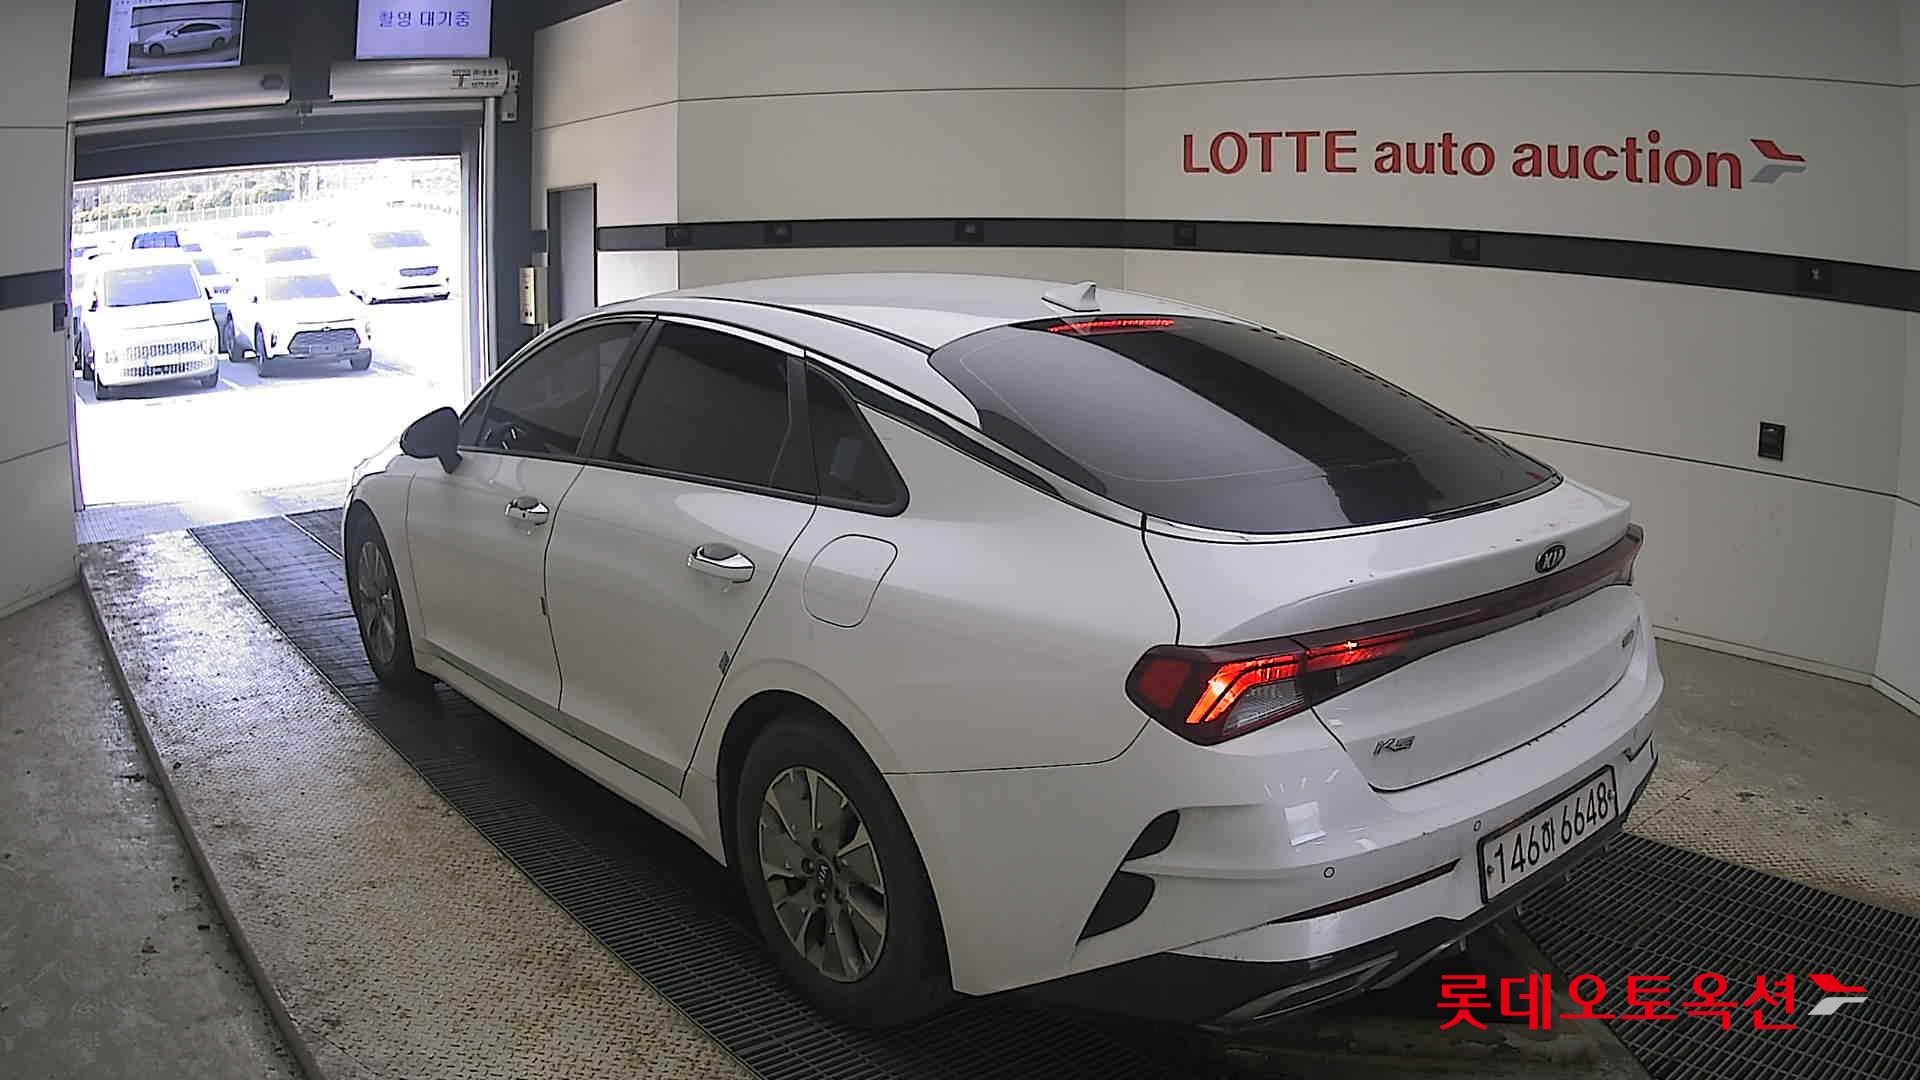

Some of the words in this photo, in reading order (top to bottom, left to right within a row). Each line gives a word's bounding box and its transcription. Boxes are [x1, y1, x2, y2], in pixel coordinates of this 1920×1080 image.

[379, 10, 411, 28] 촬영
[420, 10, 471, 28] 대기중
[1183, 129, 1357, 174] LOTTE
[1374, 132, 1495, 177] auto
[1511, 130, 1742, 190] auction
[1561, 782, 1608, 844] 6648
